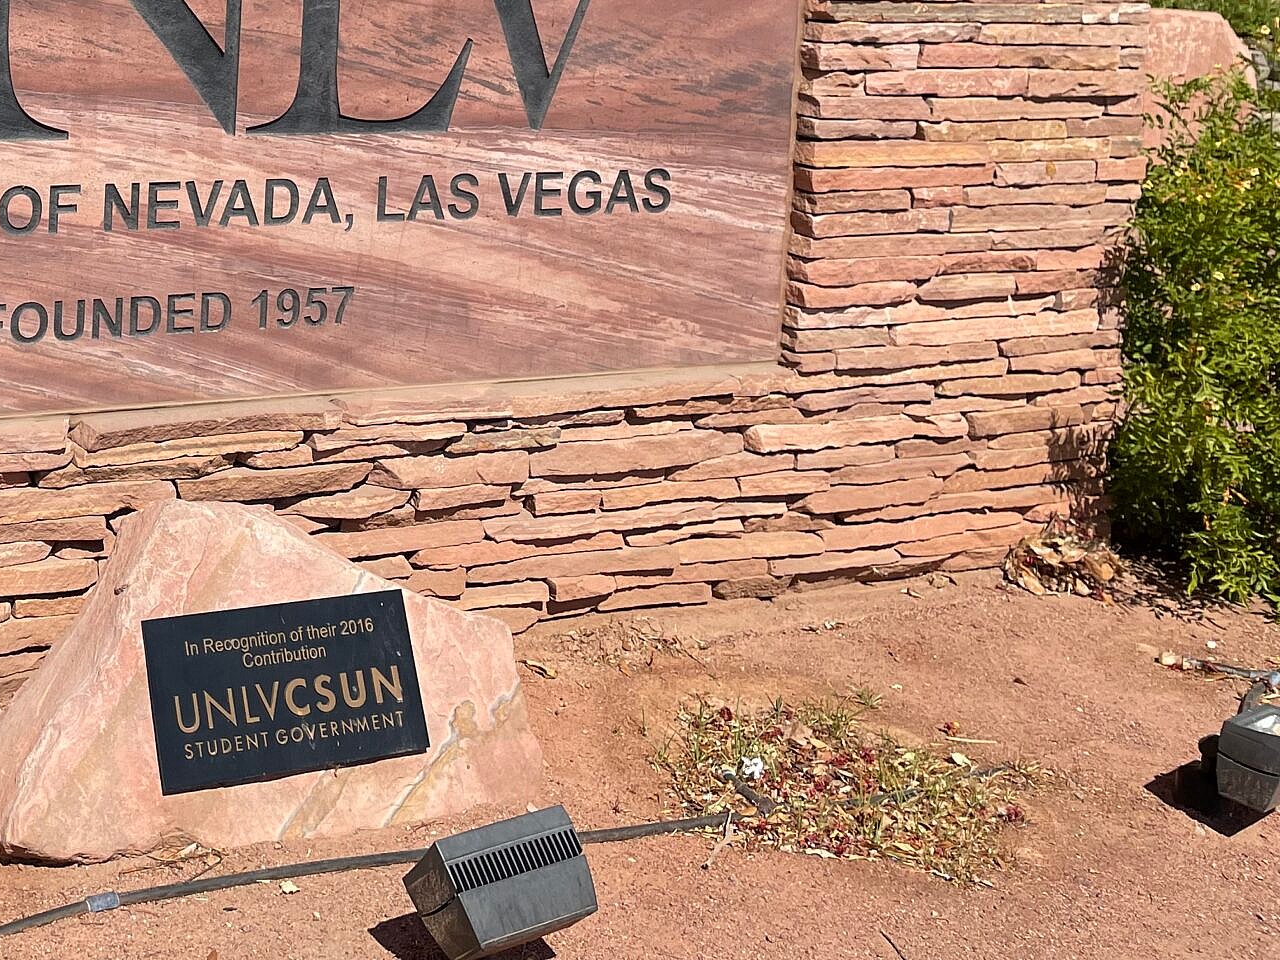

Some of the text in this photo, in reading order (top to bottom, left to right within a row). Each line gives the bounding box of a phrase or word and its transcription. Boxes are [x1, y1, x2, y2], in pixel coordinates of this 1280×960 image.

[103, 178, 357, 234] NEVADA,
[377, 174, 480, 222] LAS
[499, 168, 673, 218] VEGAS
[253, 286, 356, 331] 1957
[184, 618, 374, 656] In Recognition of their 2016
[242, 646, 327, 669] Contribution
[173, 664, 404, 734] UNLVCSUN
[184, 710, 405, 760] STUDENT GOVERNMENT
